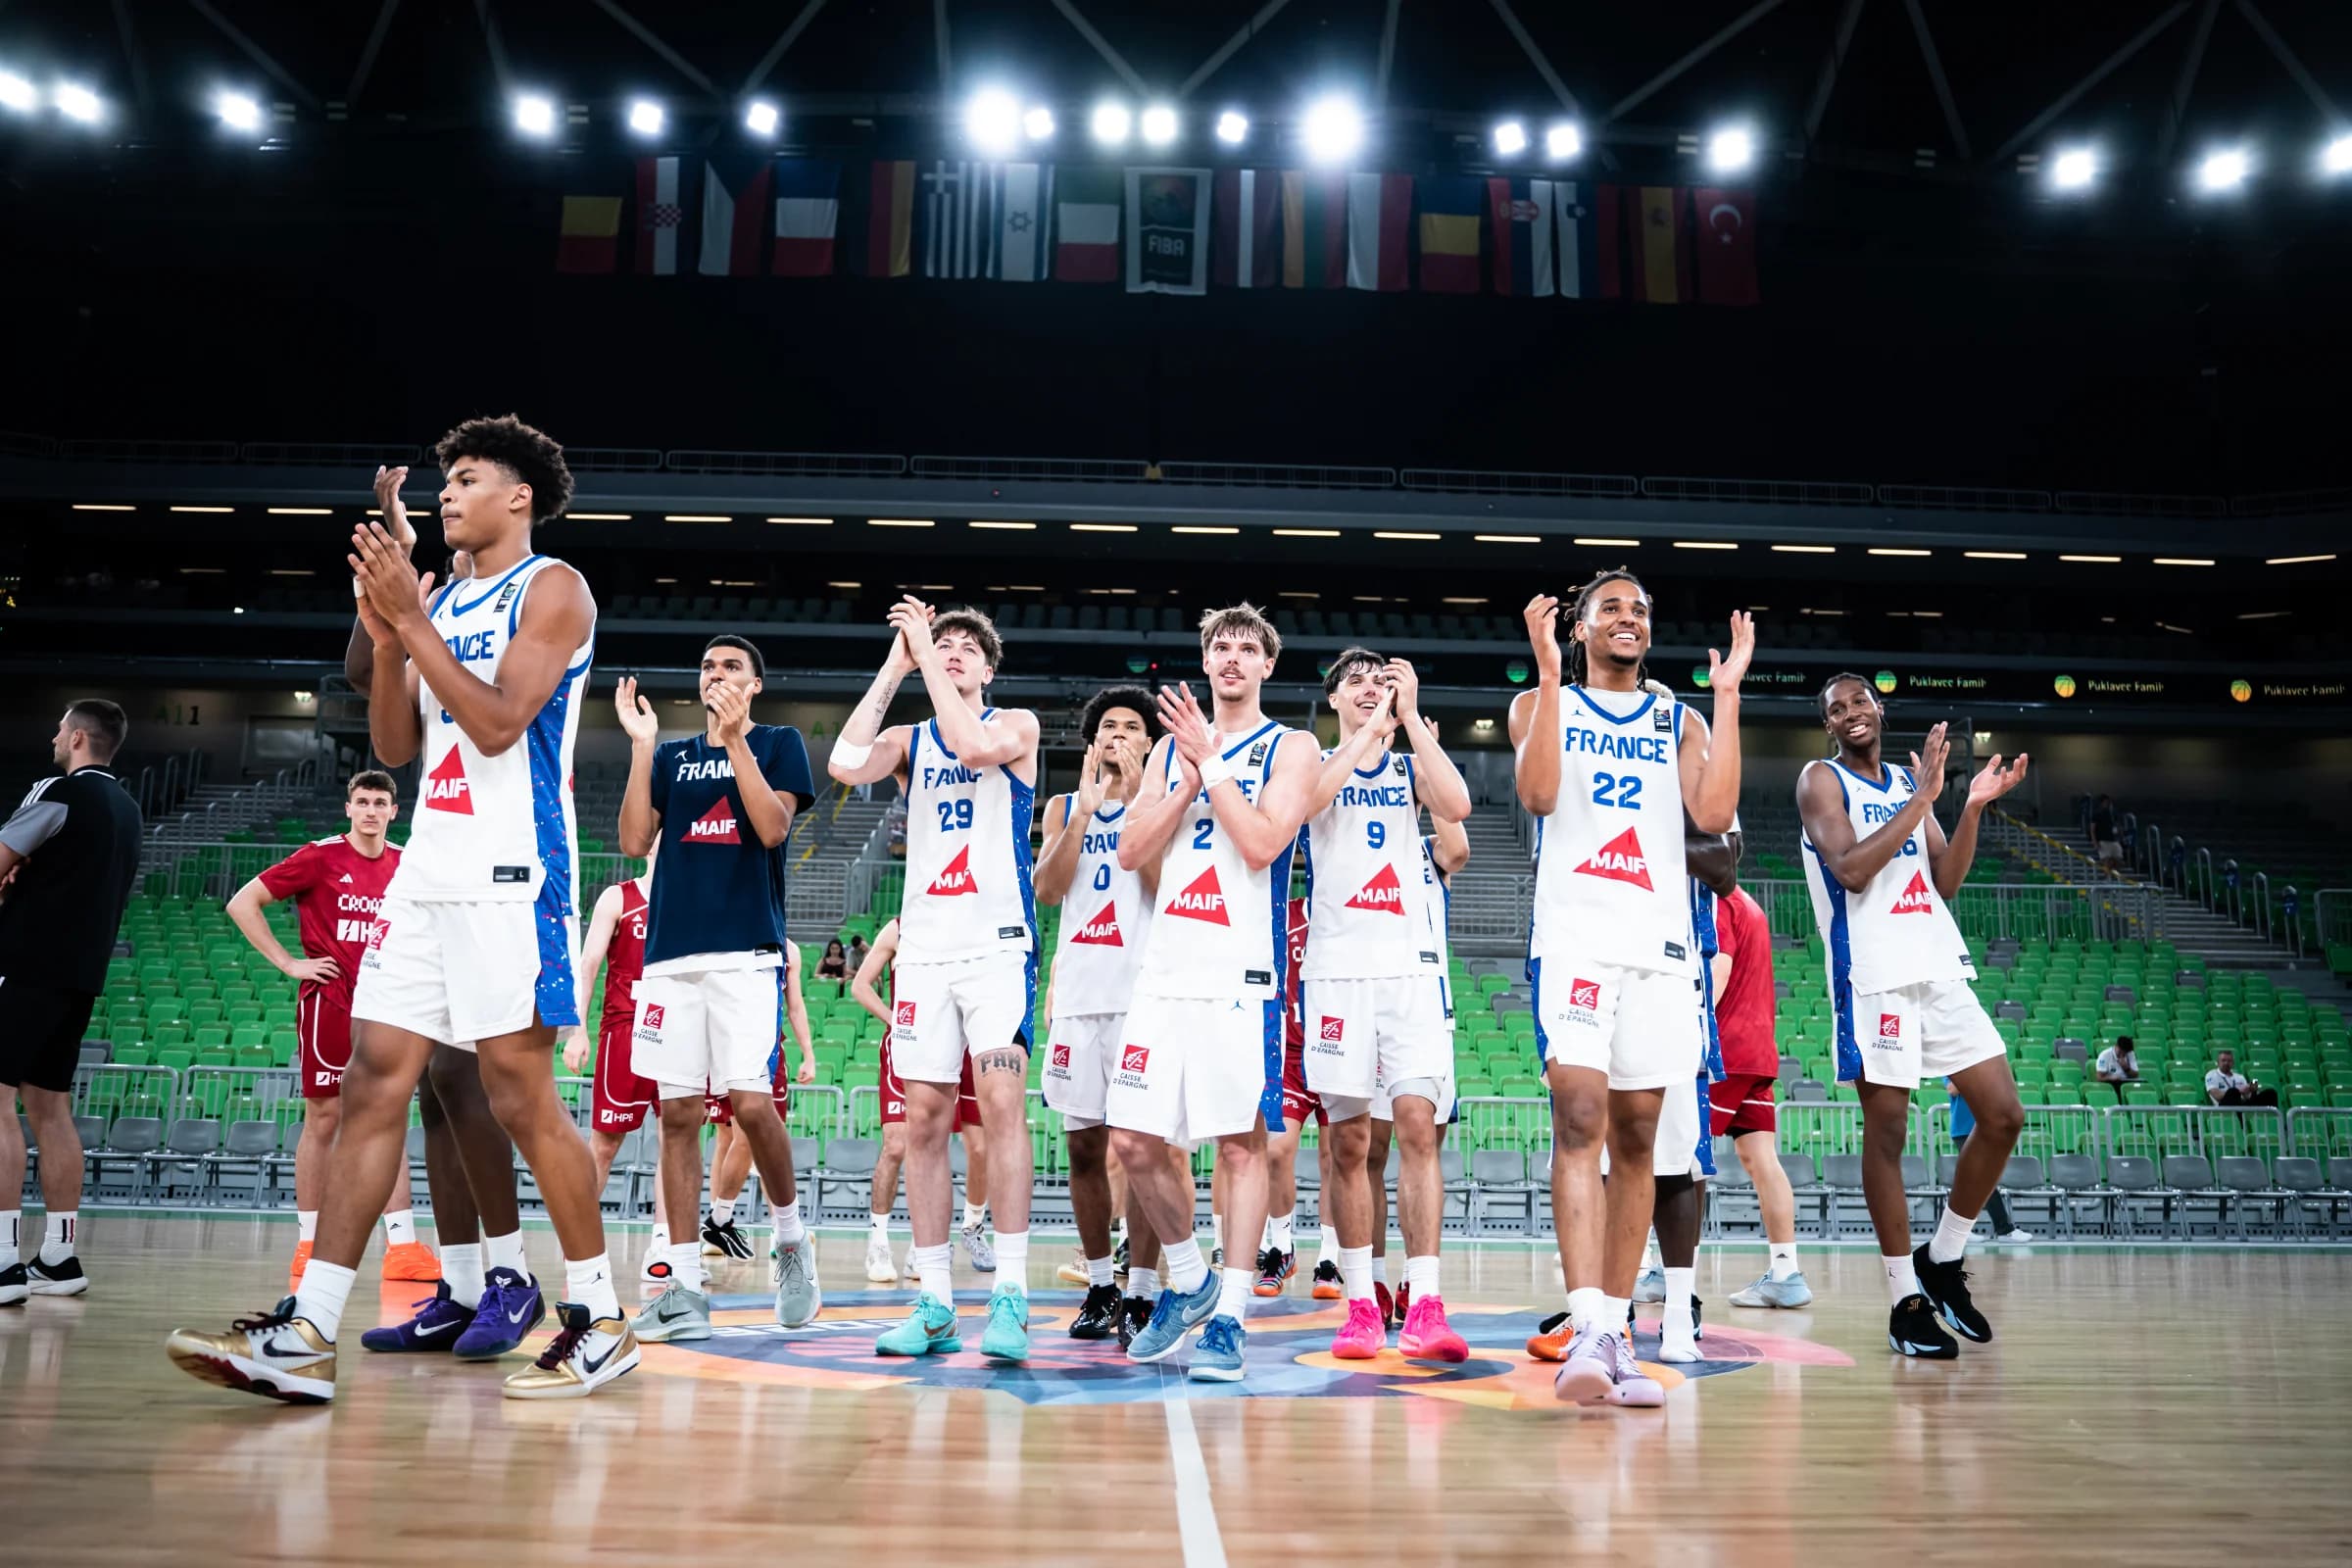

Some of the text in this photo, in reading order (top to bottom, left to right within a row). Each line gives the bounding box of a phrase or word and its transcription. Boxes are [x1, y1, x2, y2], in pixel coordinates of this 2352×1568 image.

[1148, 234, 1185, 257] FIBA
[447, 630, 495, 662] NCE
[1565, 727, 1669, 765] FRANCE
[676, 760, 736, 782] FRAN
[1592, 771, 1642, 810] 22
[938, 798, 973, 833] 29
[691, 819, 737, 837] MAIF
[1193, 818, 1214, 850] 2
[1366, 820, 1386, 849] 9
[1080, 832, 1120, 855] RAN
[1590, 852, 1646, 875] MAIF
[1093, 863, 1111, 891] 0
[338, 894, 384, 914] CROA
[1173, 893, 1224, 911] MAIF
[1356, 886, 1401, 904] MAIF
[1081, 921, 1118, 939] MAIF
[1119, 1072, 1142, 1083] CAISSE
